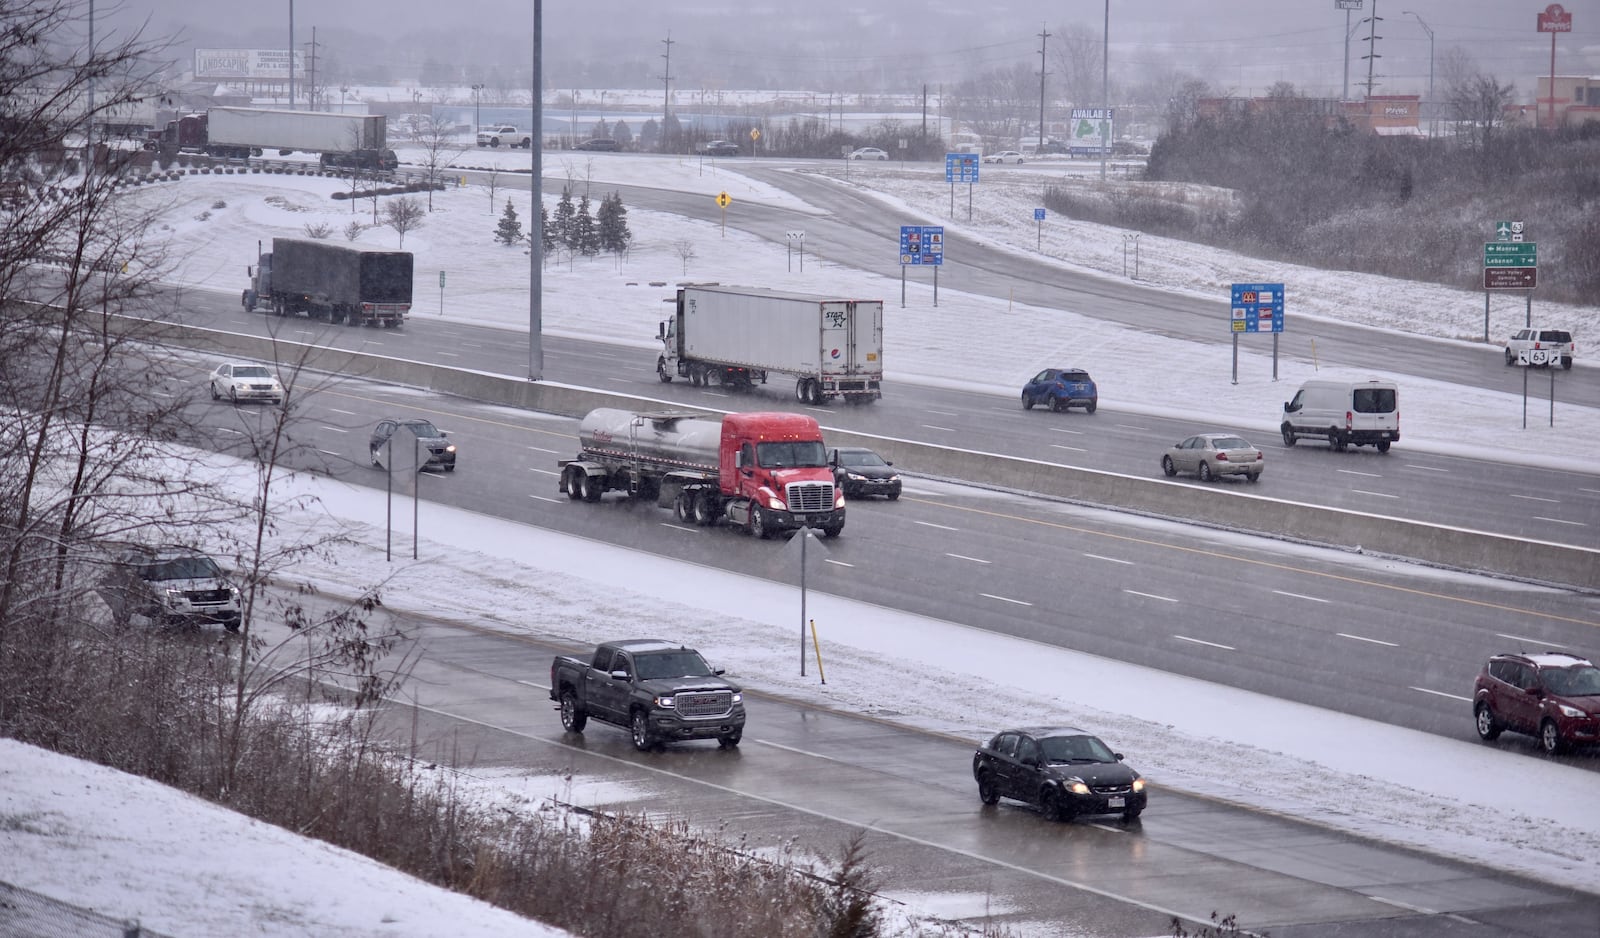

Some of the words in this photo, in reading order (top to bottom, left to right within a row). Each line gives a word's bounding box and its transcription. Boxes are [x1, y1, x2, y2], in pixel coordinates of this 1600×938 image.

[198, 57, 249, 75] LANDSCAPING
[1072, 109, 1111, 118] AVAILABE
[1512, 223, 1522, 231] 63
[825, 311, 844, 319] STAR
[1533, 352, 1545, 361] 63
